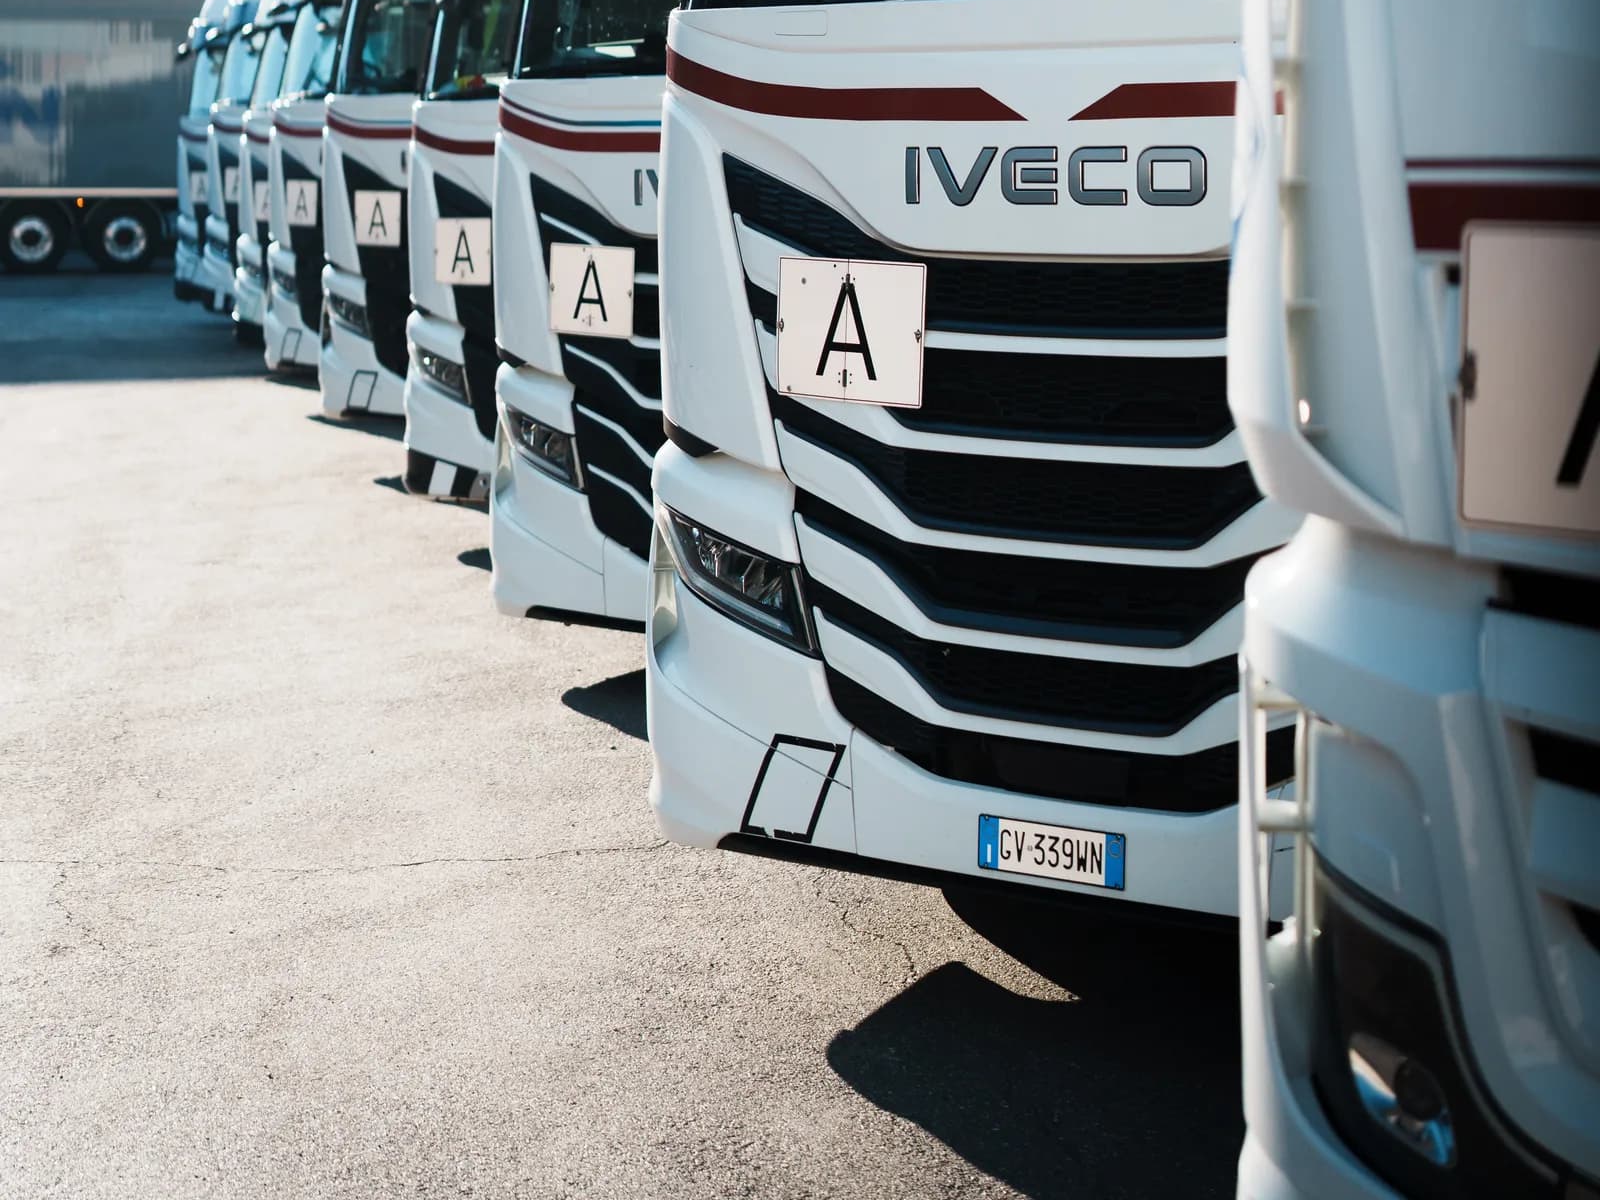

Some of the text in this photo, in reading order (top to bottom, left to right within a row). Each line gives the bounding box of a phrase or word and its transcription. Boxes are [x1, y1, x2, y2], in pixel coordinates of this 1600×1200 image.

[294, 186, 309, 218] A
[904, 145, 1208, 207] IVECO
[368, 198, 388, 237] A
[451, 226, 474, 273] A
[573, 257, 608, 322] A
[815, 280, 877, 381] A
